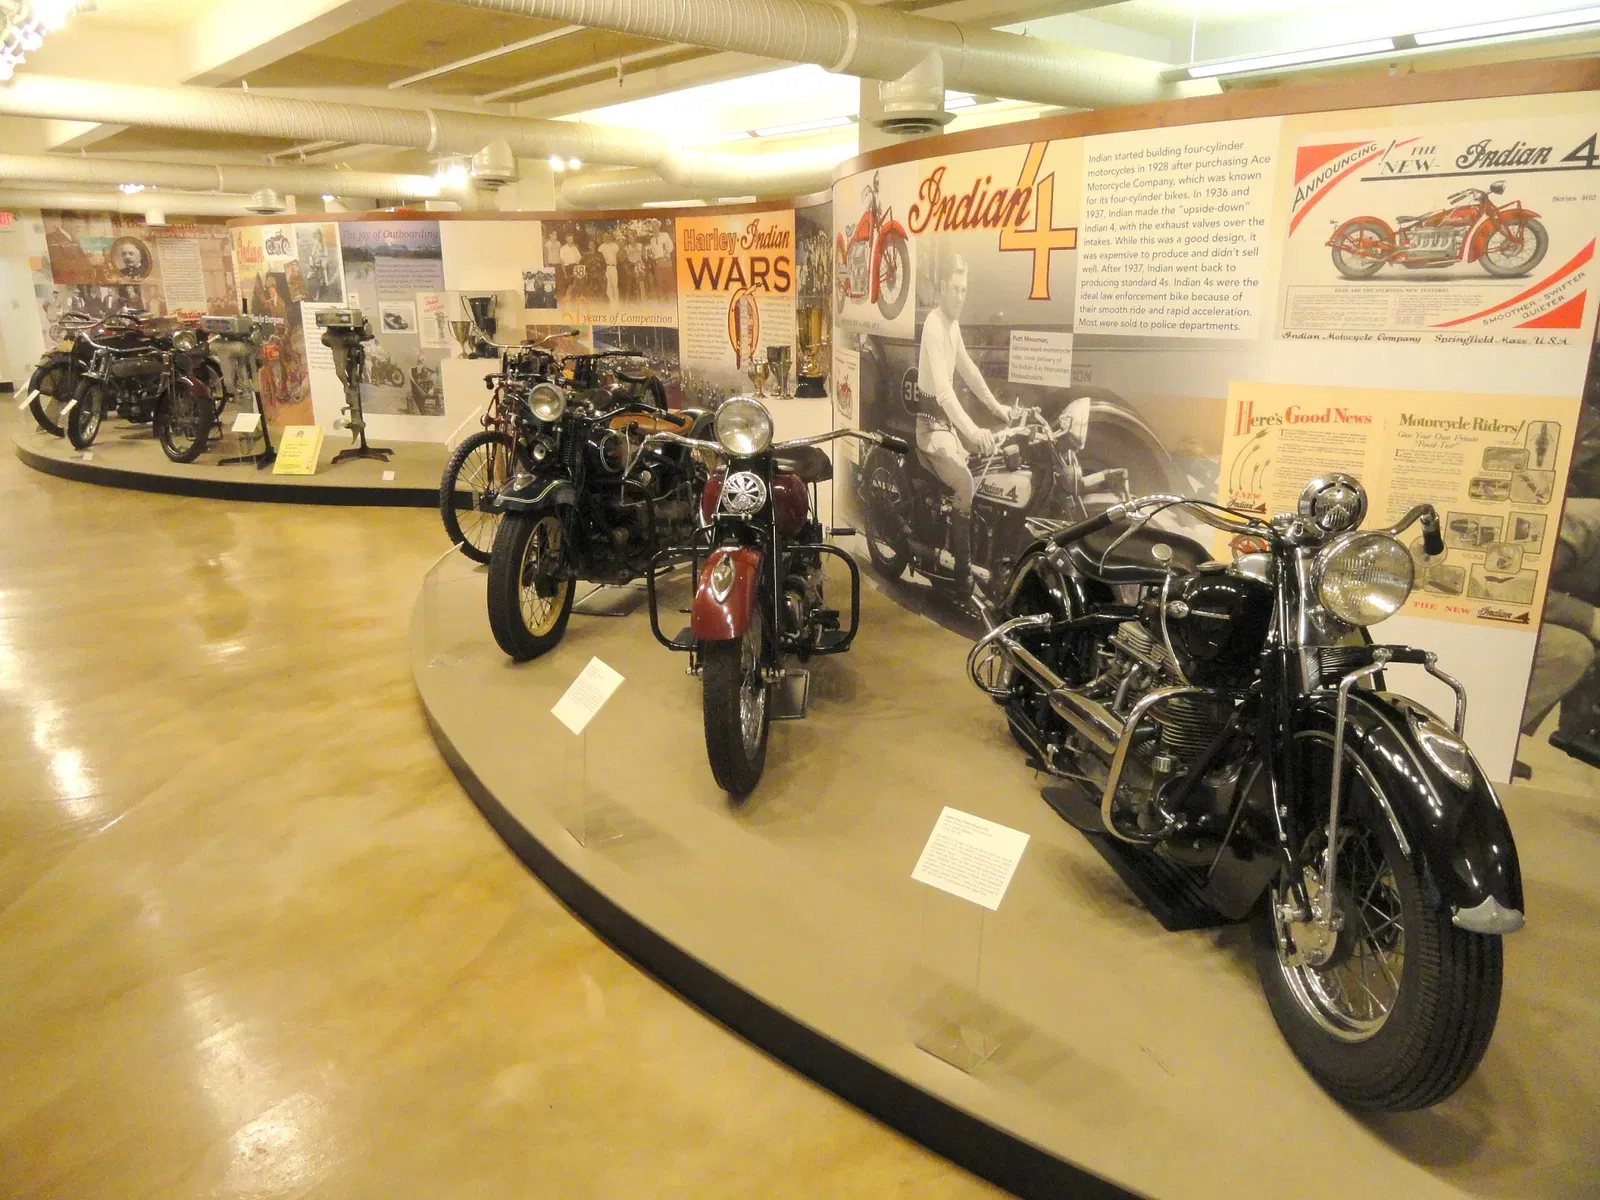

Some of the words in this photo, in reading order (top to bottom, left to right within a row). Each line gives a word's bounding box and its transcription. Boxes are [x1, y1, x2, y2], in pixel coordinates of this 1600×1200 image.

[1089, 155, 1112, 163] Indian
[1115, 151, 1144, 161] started
[1146, 147, 1181, 158] building
[1184, 141, 1244, 154] four-cylinder
[1411, 146, 1436, 155] THE
[1456, 139, 1553, 169] Indian
[1560, 132, 1599, 169] 4
[1088, 166, 1135, 177] motorcycles
[1137, 164, 1145, 172] in
[1148, 163, 1168, 172] 1928
[1171, 161, 1192, 170] after
[1195, 157, 1248, 171] purchasing
[1251, 155, 1271, 164] Ace
[1087, 178, 1131, 192] Motorcycle
[1133, 177, 1176, 188] Company,
[1178, 174, 1204, 184] which
[1229, 172, 1261, 181] known
[1087, 197, 1096, 205] for
[1099, 196, 1108, 204] its
[1111, 192, 1161, 204] four-cylinder
[1164, 191, 1190, 200] bikes.
[1193, 189, 1202, 198] In
[1206, 188, 1227, 197] 1936
[1231, 187, 1249, 196] and
[1087, 210, 1106, 219] 1937,
[1109, 209, 1132, 217] Indian
[1135, 207, 1158, 216] made
[1161, 206, 1175, 214] the
[1179, 202, 1250, 215] "upside-down"
[908, 166, 1033, 234] Indian
[999, 141, 1078, 300] 4
[1085, 224, 1107, 232] Indian
[1110, 224, 1117, 232] 4,
[1120, 222, 1136, 231] with
[1139, 221, 1153, 230] the
[1155, 219, 1189, 229] exhaust
[1192, 218, 1220, 228] valves
[1224, 219, 1245, 227] over
[1249, 217, 1265, 226] the
[359, 230, 371, 239] Joy
[373, 230, 381, 238] of
[383, 229, 438, 239] Outboarding
[1084, 237, 1112, 245] intakes.
[1115, 236, 1137, 245] While
[1140, 236, 1155, 244] this
[1184, 233, 1209, 245] good
[1212, 233, 1246, 243] design,
[1250, 233, 1256, 241] it
[1099, 251, 1138, 261] expensive
[1152, 249, 1188, 260] produce
[1191, 249, 1208, 257] and
[1212, 249, 1239, 257] didn't
[1242, 247, 1258, 256] sell
[685, 256, 791, 292] WARS
[1082, 265, 1098, 273] well.
[1101, 264, 1121, 272] After
[1124, 264, 1145, 273] 1937,
[1148, 264, 1173, 272] Indian
[1201, 262, 1222, 271] back
[1081, 278, 1119, 288] producing
[1121, 278, 1156, 286] standard
[1174, 278, 1200, 286] Indian
[1080, 292, 1098, 300] ideal
[1100, 292, 1112, 300] law
[1115, 292, 1167, 300] enforcement
[1170, 292, 1189, 301] bike
[1191, 293, 1229, 301] because
[1232, 292, 1243, 301] of
[1482, 301, 1536, 326] SMOOTHER
[1544, 272, 1586, 300] SWIFTER
[1130, 306, 1146, 314] ride
[1148, 306, 1164, 314] and
[1166, 307, 1189, 317] rapid
[1192, 307, 1252, 316] acceleration.
[1522, 295, 1565, 319] QUIETER
[582, 314, 607, 323] years
[610, 313, 619, 324] of
[620, 313, 672, 324] Competition
[1121, 319, 1137, 327] sold
[1140, 320, 1148, 328] to
[1151, 320, 1176, 330] police
[1179, 321, 1241, 332] departments.
[1281, 332, 1320, 340] Indian
[1322, 332, 1373, 342] Motocycle
[1377, 333, 1421, 344] Company
[1234, 401, 1282, 436] Here's
[1285, 405, 1331, 424] Good
[1334, 408, 1372, 424] News
[1400, 413, 1470, 431] Motorcycle
[976, 478, 1003, 496] Indian
[1227, 499, 1253, 509] Indian
[1413, 601, 1437, 610] THE
[1445, 606, 1471, 614] NEW
[1478, 606, 1512, 619] Indian
